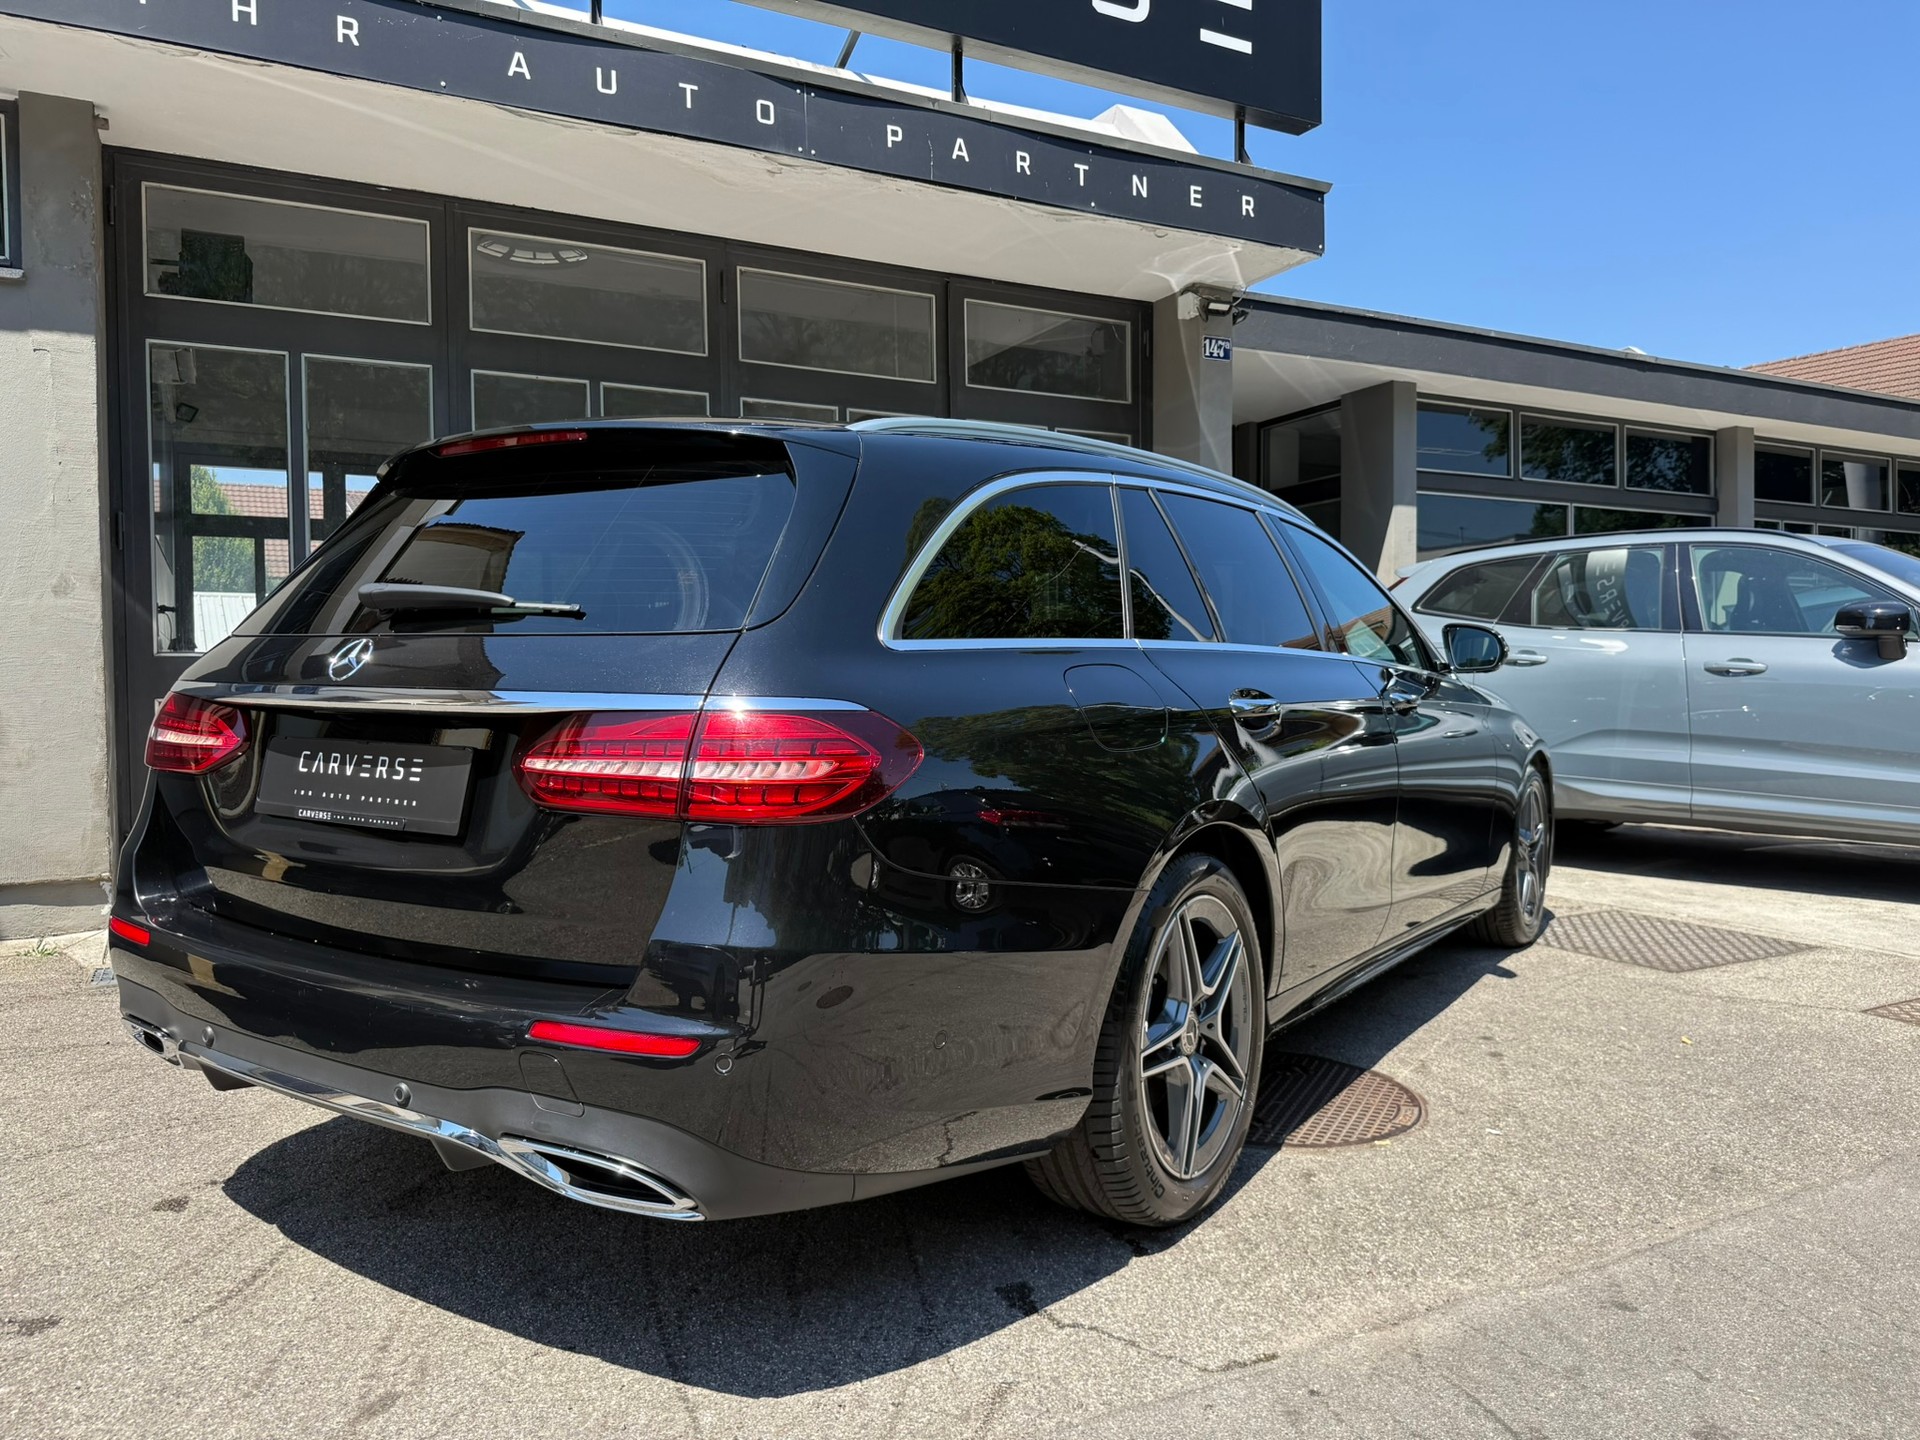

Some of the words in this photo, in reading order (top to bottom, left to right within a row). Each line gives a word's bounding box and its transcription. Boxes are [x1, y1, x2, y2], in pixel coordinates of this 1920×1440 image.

[140, 0, 359, 46] HR
[508, 52, 774, 125] AUTO
[887, 125, 1257, 217] PARTNER
[298, 750, 424, 782] CARVERSE
[298, 808, 332, 820] CARVERSE
